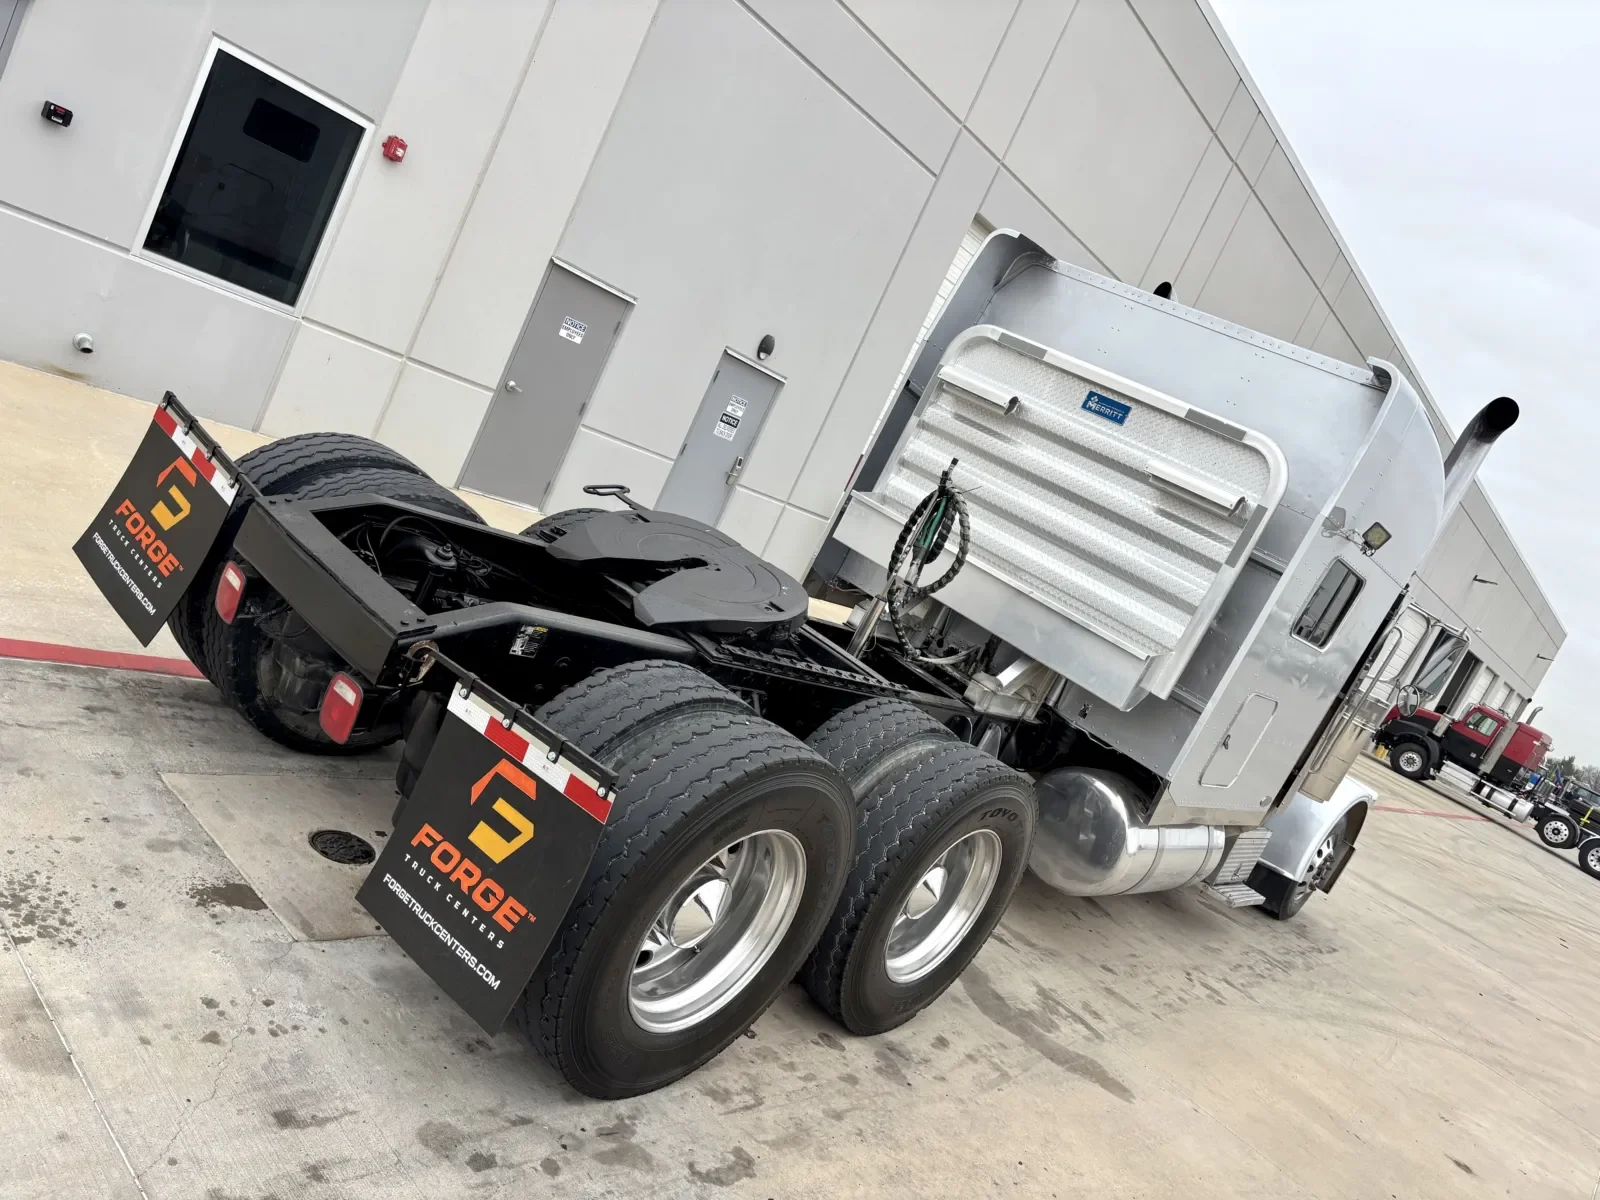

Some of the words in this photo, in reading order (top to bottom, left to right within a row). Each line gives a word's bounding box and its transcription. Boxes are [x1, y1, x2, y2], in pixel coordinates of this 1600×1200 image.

[565, 317, 587, 333] NOTICE
[566, 332, 576, 340] ONLY
[721, 414, 739, 427] NOTICE
[1086, 401, 1123, 419] MERRITT
[108, 519, 130, 547] TRUCK
[130, 548, 162, 588] CENTERS
[115, 499, 180, 578] FORGE
[92, 532, 156, 616] FORGETRUCKCENTERS.COM
[977, 807, 1020, 824] TOYO
[404, 853, 442, 892] TRUCK
[446, 894, 505, 949] CENTERS
[410, 823, 528, 933] FORGE
[382, 873, 501, 990] FORGETRUCKCENTERS.COM
